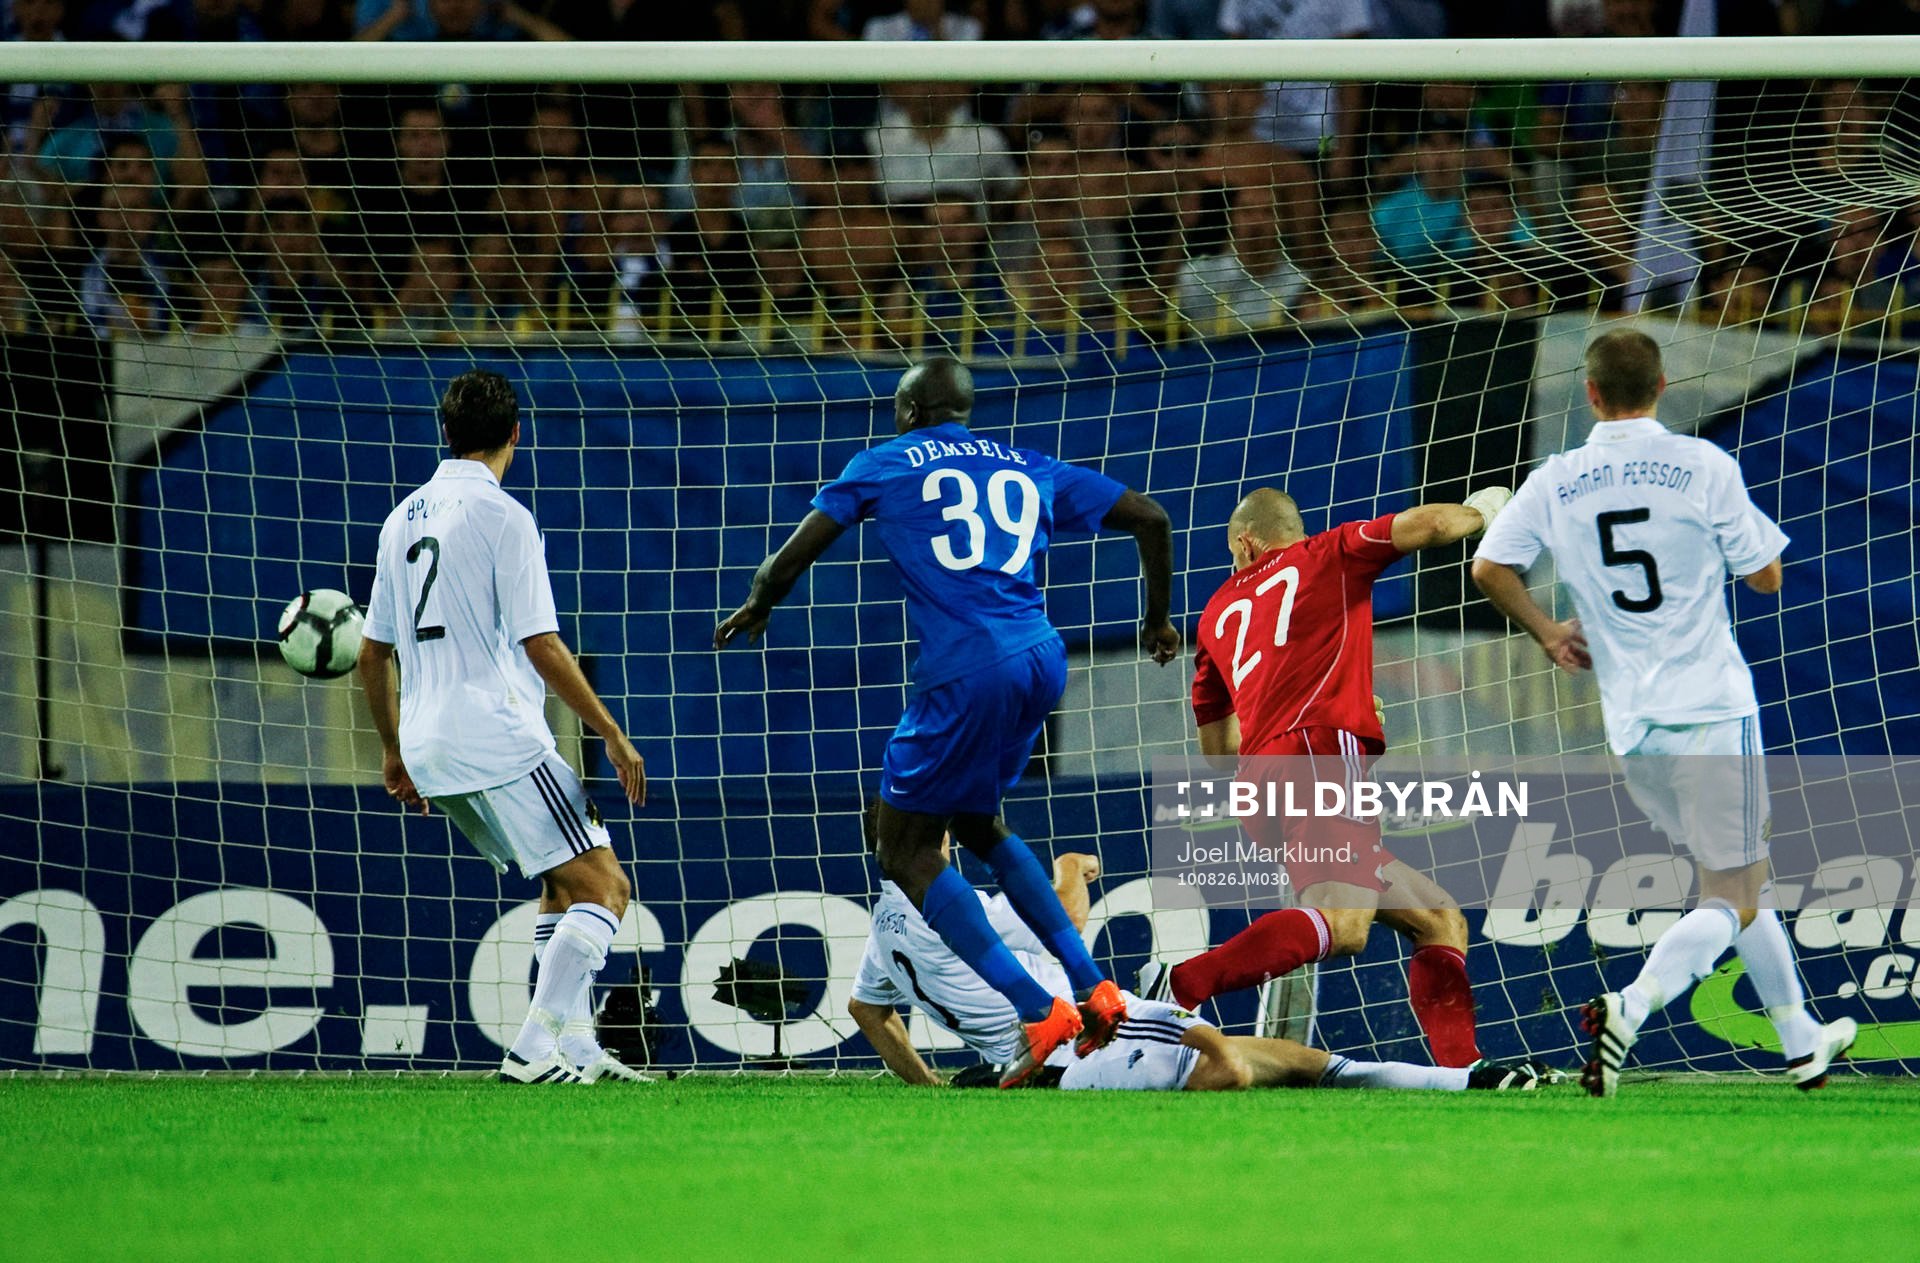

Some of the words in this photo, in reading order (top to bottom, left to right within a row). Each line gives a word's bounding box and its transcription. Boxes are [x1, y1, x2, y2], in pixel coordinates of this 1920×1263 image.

[905, 439, 1028, 467] DEMBELE
[922, 468, 1040, 574] 39
[1596, 507, 1663, 613] 5
[406, 536, 446, 643] 2
[1215, 566, 1299, 691] 27
[1482, 822, 1920, 949] be-a
[1837, 953, 1920, 1000] .c
